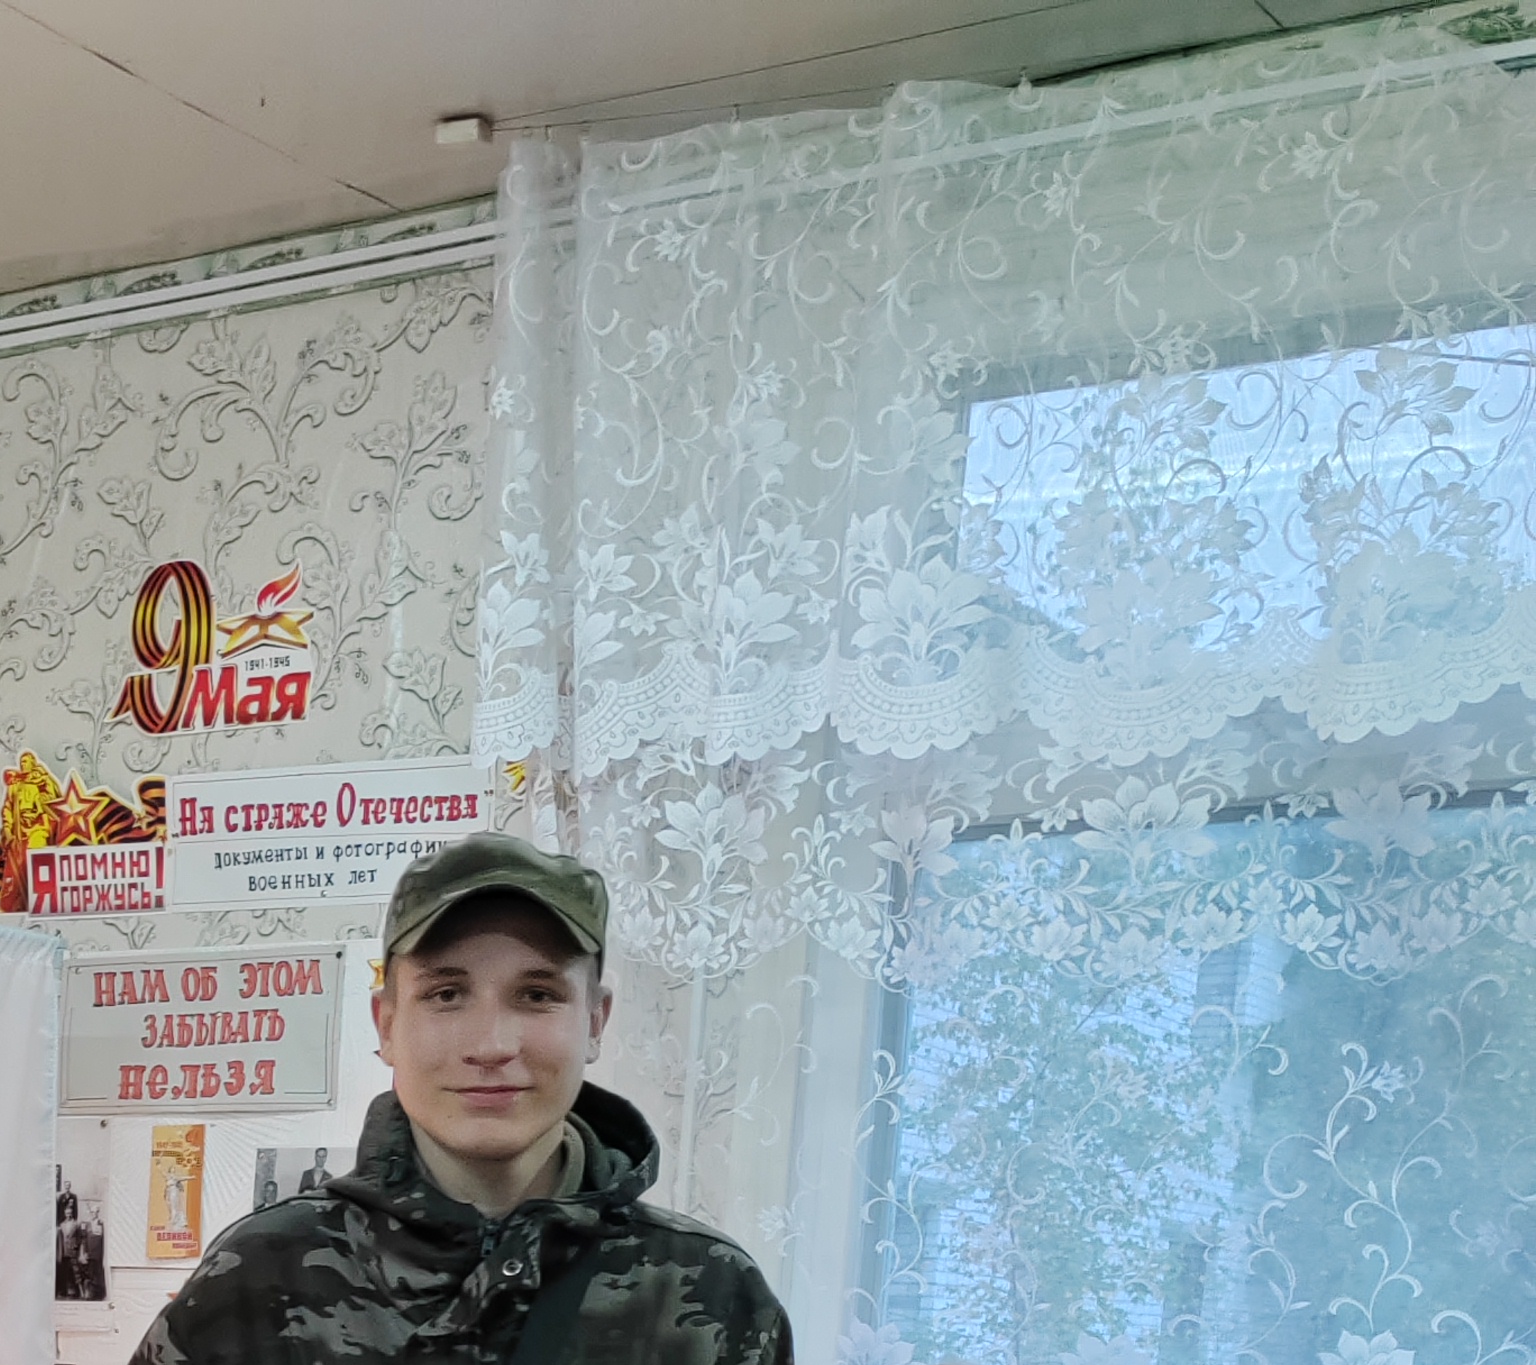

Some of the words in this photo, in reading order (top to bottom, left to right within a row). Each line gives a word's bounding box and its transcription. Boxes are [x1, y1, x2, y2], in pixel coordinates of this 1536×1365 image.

[109, 561, 212, 733] 9
[181, 665, 311, 729] Мая
[225, 800, 327, 832] страже
[316, 845, 325, 859] и
[31, 853, 58, 914] Я
[60, 850, 151, 882] ПОМНЮ
[248, 872, 334, 892] военных
[348, 868, 378, 885] лет
[93, 969, 170, 1007] НАМ
[181, 967, 218, 1001] ОБ
[239, 959, 324, 999] ЭТОМ
[141, 1008, 285, 1048] ЗАБЫВАТЬ
